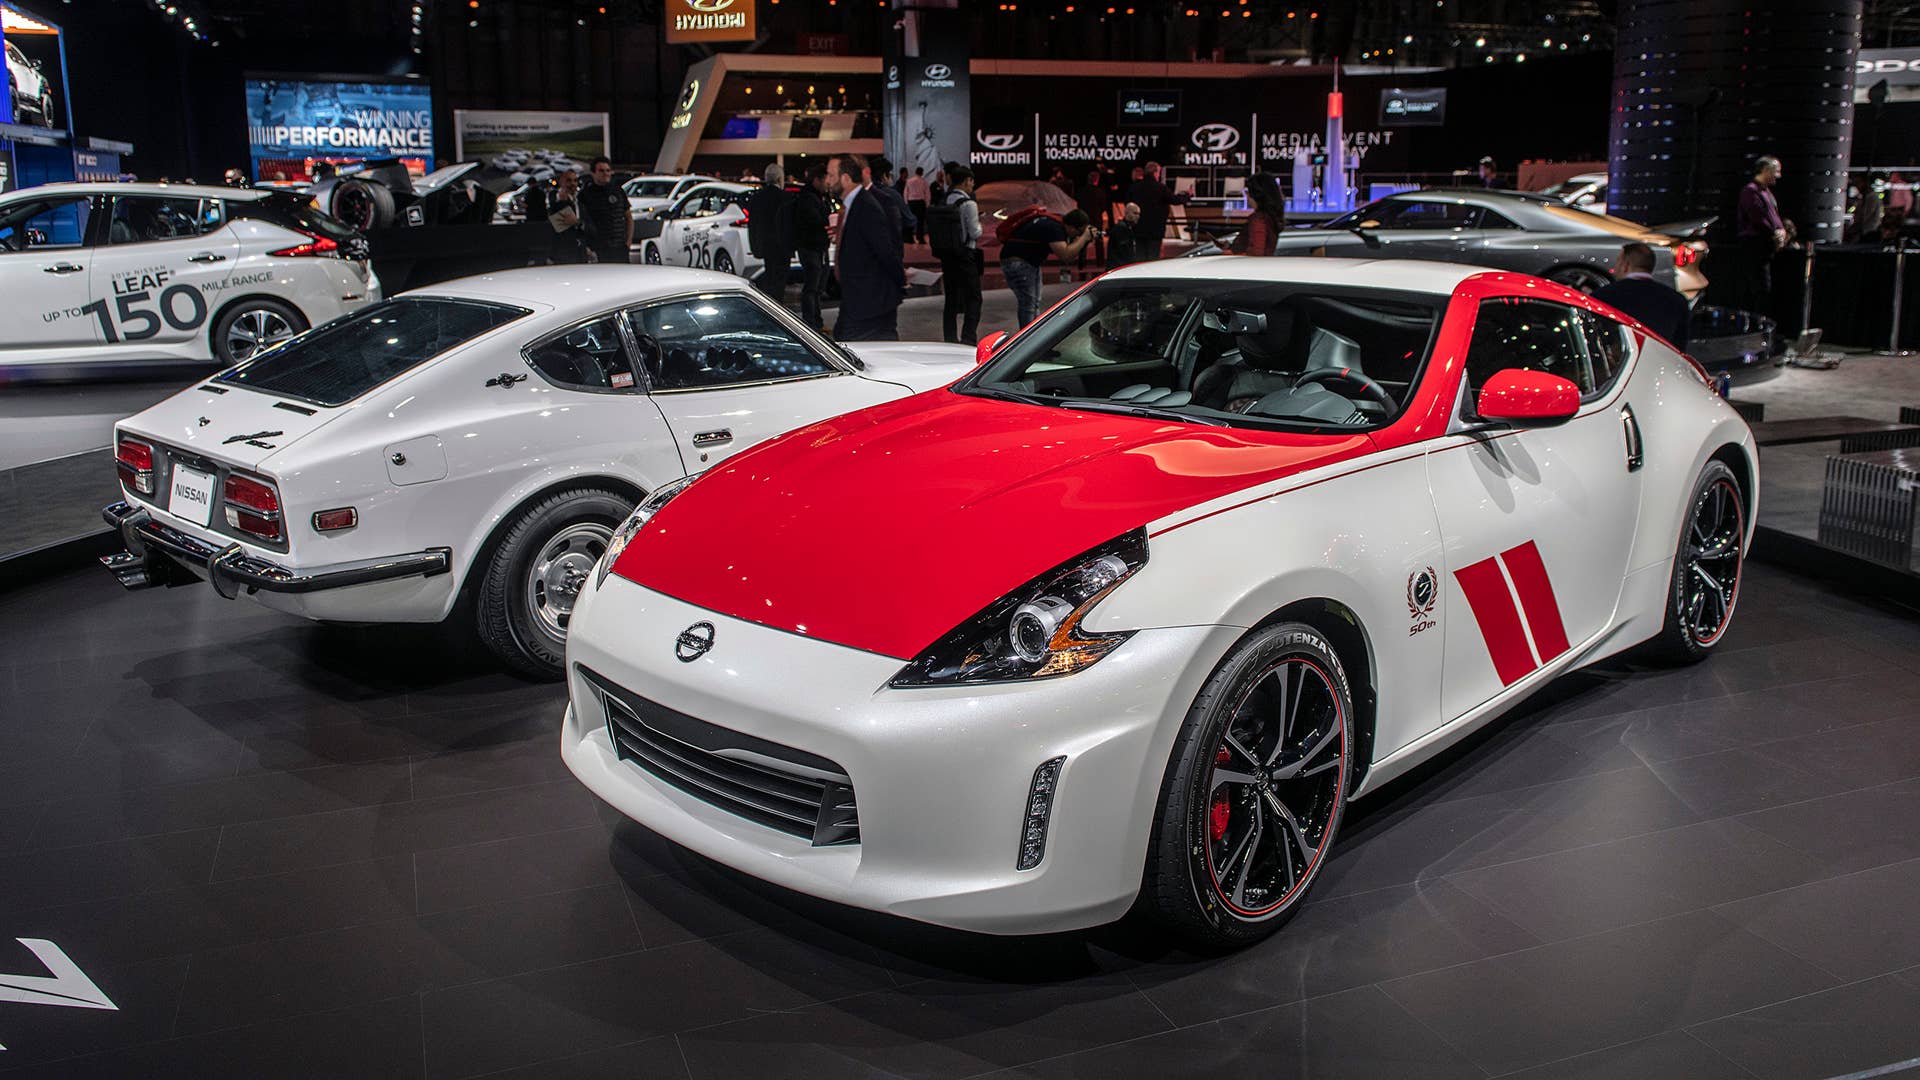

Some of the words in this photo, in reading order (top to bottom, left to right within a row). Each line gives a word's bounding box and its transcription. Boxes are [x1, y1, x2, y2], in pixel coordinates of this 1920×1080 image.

[675, 12, 745, 31] HYUNDAI
[808, 36, 836, 50] EXIT
[355, 110, 431, 128] WINNING
[275, 126, 432, 147] PERFORMANCE
[1045, 134, 1098, 147] MEDIA
[1105, 134, 1160, 148] EVENT
[1262, 132, 1321, 146] MEDIA
[1342, 131, 1394, 146] VENT
[970, 152, 1030, 165] HYUNDAI
[1044, 147, 1096, 160] 10:45AM
[1098, 148, 1139, 161] TODAY
[1184, 152, 1246, 165] HYUNI
[683, 241, 711, 269] 226
[42, 312, 60, 324] UP
[62, 307, 82, 320] TO
[82, 284, 208, 344] 150
[201, 279, 231, 293] MILE
[232, 271, 274, 287] RANGE
[174, 483, 208, 505] NISSAN
[1409, 620, 1437, 638] 50th
